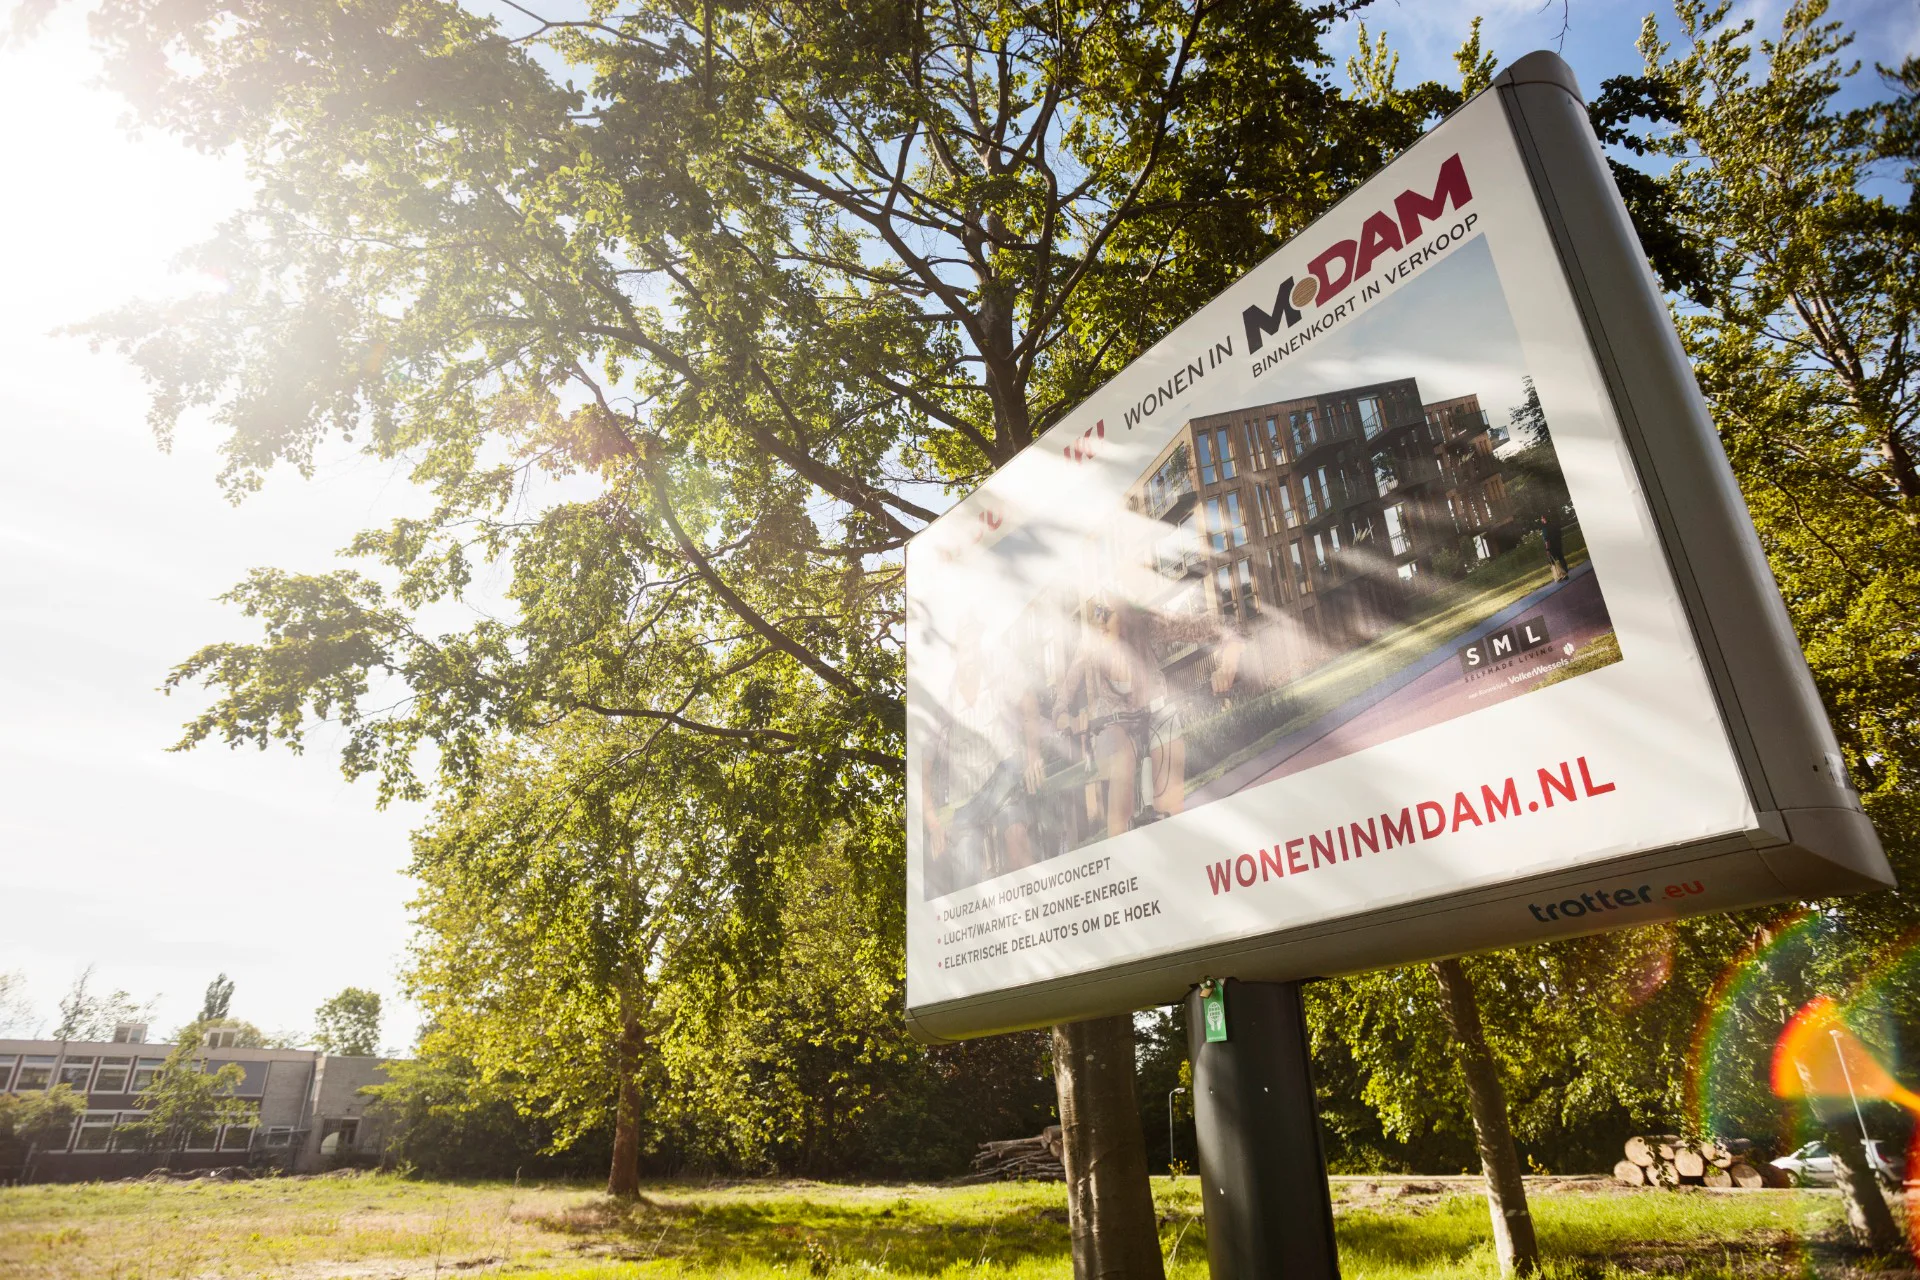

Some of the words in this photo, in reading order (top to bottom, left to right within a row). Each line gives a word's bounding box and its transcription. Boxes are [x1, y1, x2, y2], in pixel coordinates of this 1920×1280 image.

[1253, 296, 1356, 379] BINNENKORT
[1361, 280, 1381, 303] IN
[1384, 213, 1478, 284] VERKOOP
[1123, 356, 1205, 430] WONEN
[1208, 335, 1233, 370] IN
[1464, 661, 1513, 683] SELFMADE
[1518, 645, 1553, 663] LIVING
[1507, 658, 1570, 685] VolkerWessels
[1205, 756, 1616, 896] WONENINMDAM.NL
[943, 895, 996, 922] DUURZAAM
[999, 857, 1111, 905] HOUTBOUWCONCEPT
[943, 913, 1022, 946] LUCHT/WARMTE-
[1025, 906, 1039, 922] EN
[1042, 877, 1139, 917] ZONNE-ENERGIE
[944, 941, 1009, 969] ELEKTRISCHE
[1011, 922, 1079, 952] DEELAUTO'S
[1082, 916, 1100, 933] OM
[1104, 911, 1121, 928] DE
[1124, 900, 1162, 922] HOEK
